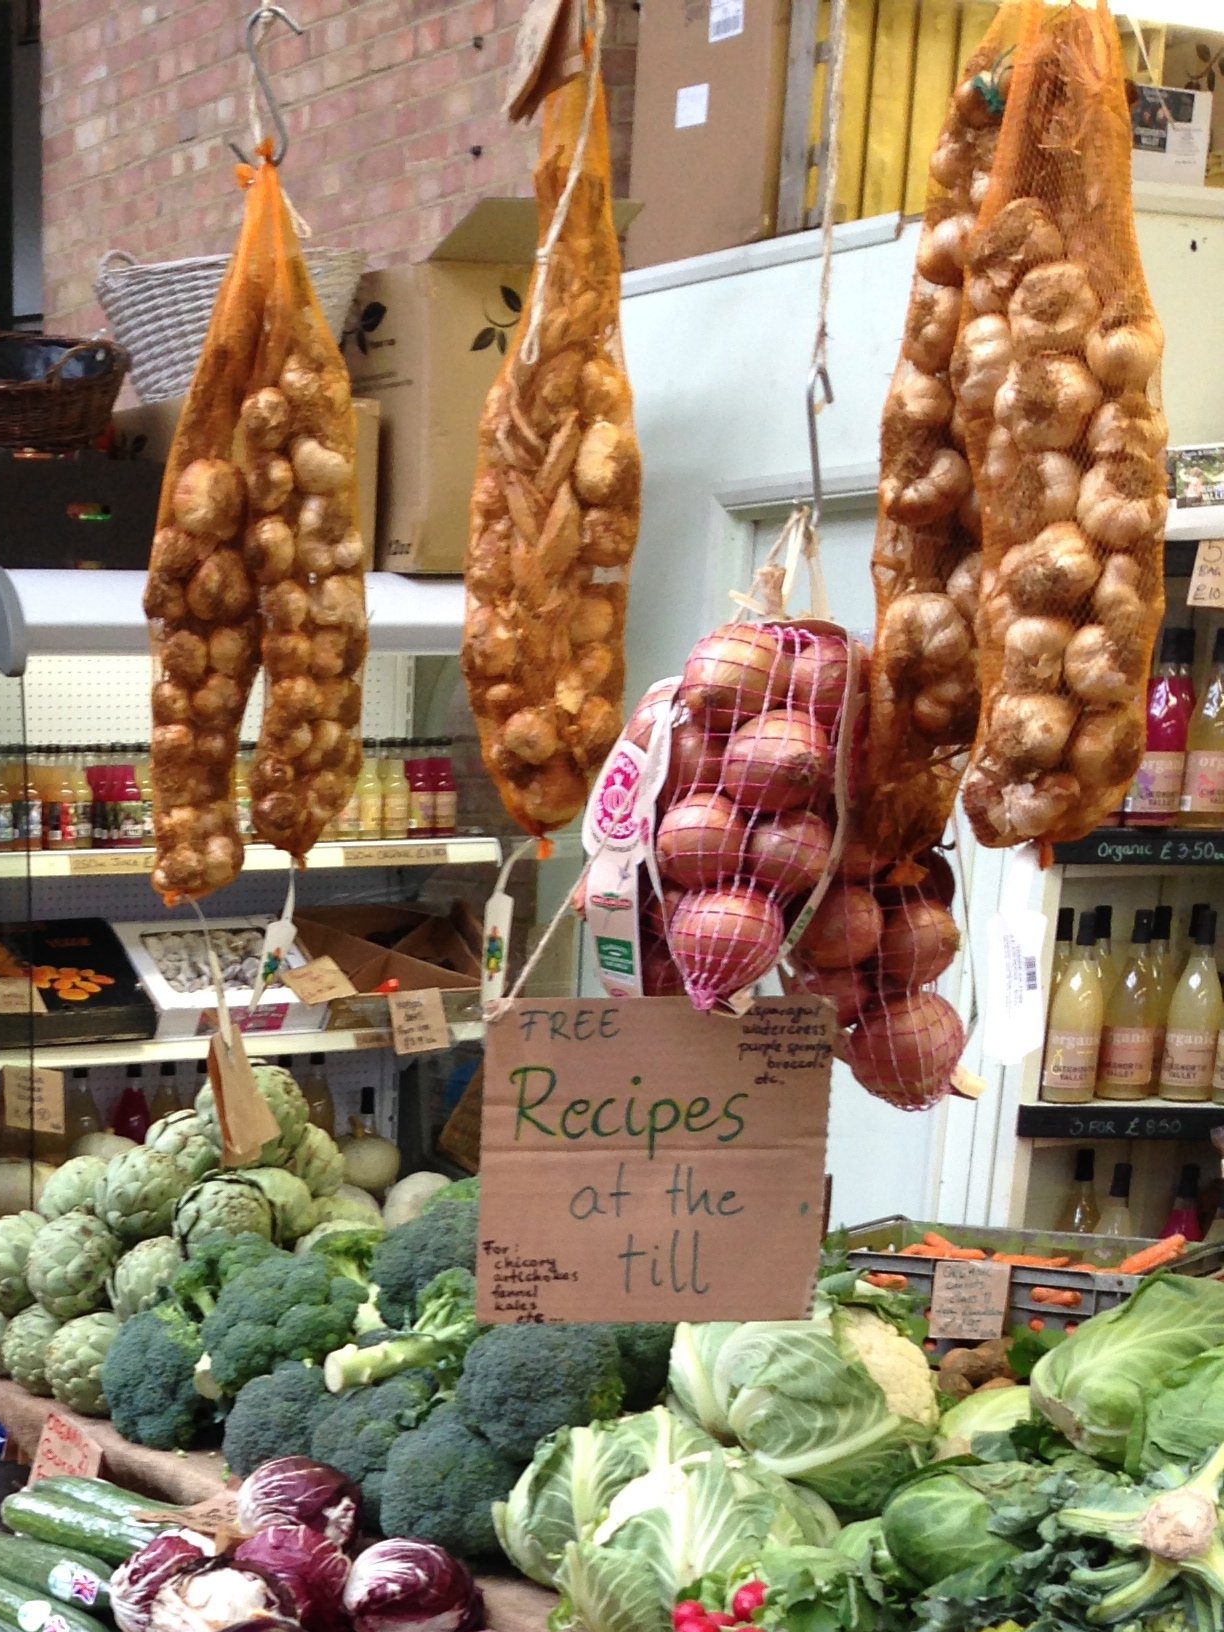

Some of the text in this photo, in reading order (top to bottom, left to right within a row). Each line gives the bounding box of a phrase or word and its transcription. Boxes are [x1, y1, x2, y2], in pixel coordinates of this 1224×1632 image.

[1098, 842, 1152, 861] Organic
[519, 1009, 620, 1041] FREE
[742, 1020, 825, 1036] watercress
[510, 1066, 749, 1160] Recipes
[1069, 1121, 1084, 1135] 3
[1088, 1121, 1116, 1133] FOR
[569, 1162, 745, 1219] at the
[494, 1257, 557, 1273] chicory
[618, 1230, 708, 1294] till
[494, 1269, 578, 1283] artichokes
[491, 1284, 538, 1298] fennel
[494, 1300, 537, 1311] kales
